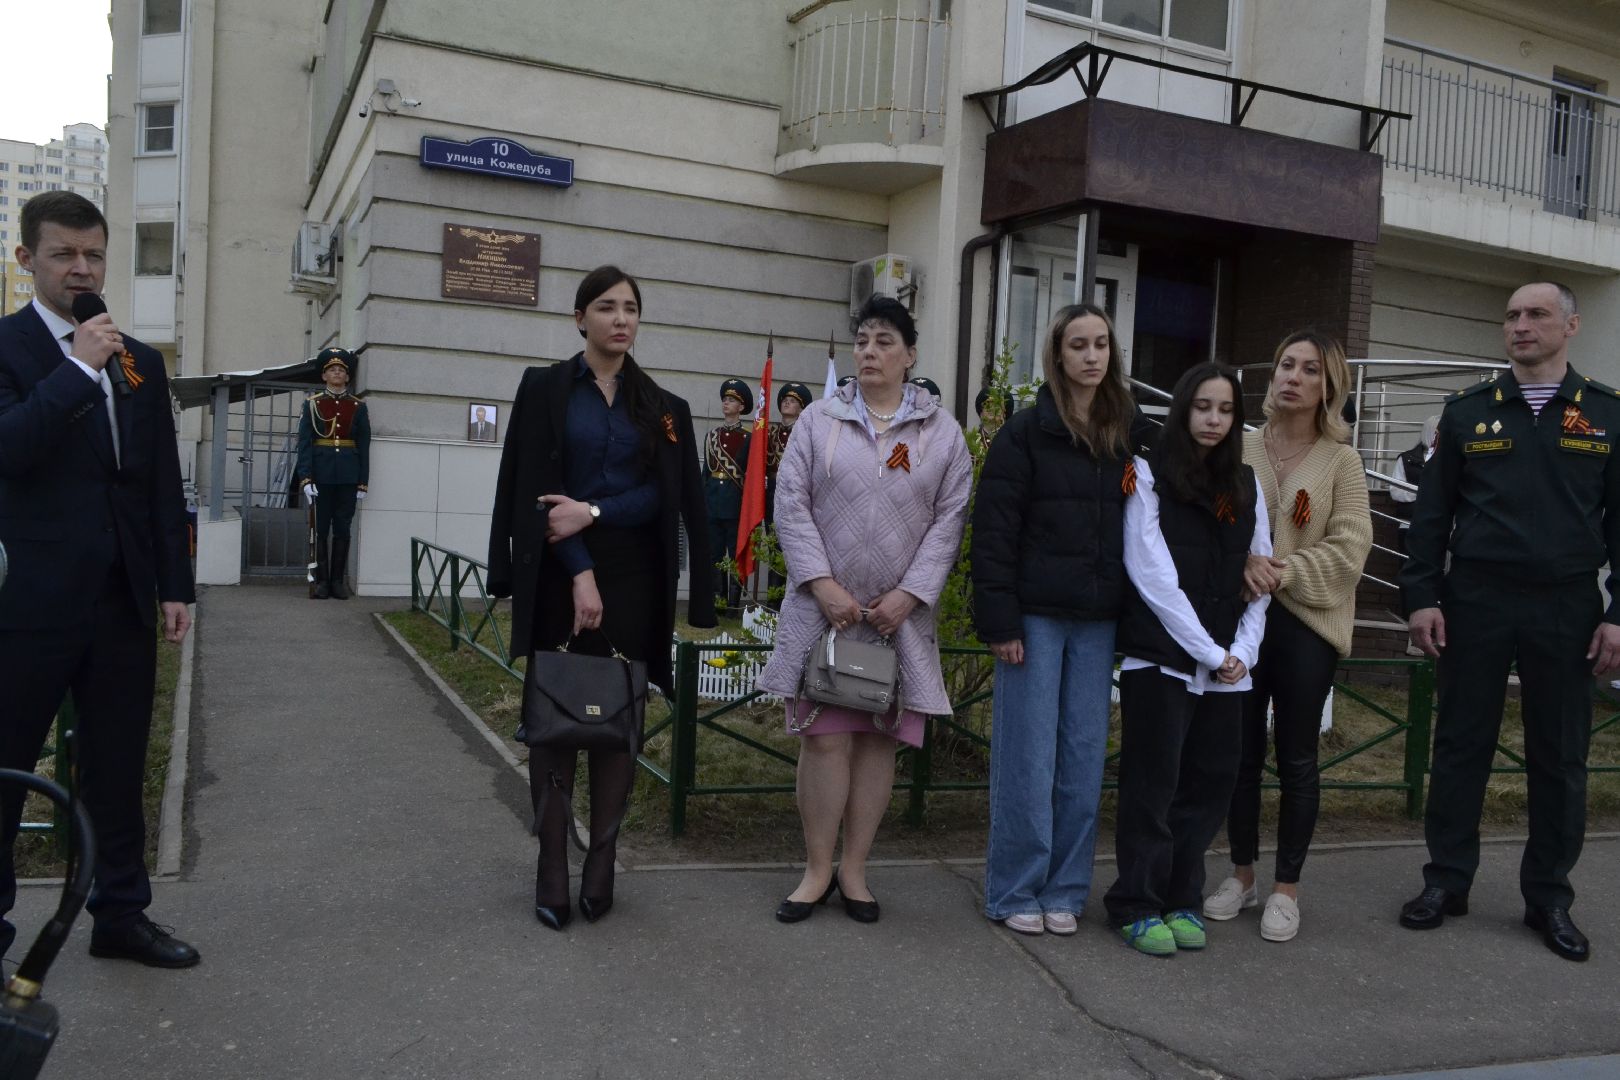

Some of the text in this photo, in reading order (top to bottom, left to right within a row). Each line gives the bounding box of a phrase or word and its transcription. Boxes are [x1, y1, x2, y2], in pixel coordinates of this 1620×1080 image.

[491, 142, 509, 156] 10
[446, 152, 551, 176] улица Кожедуба
